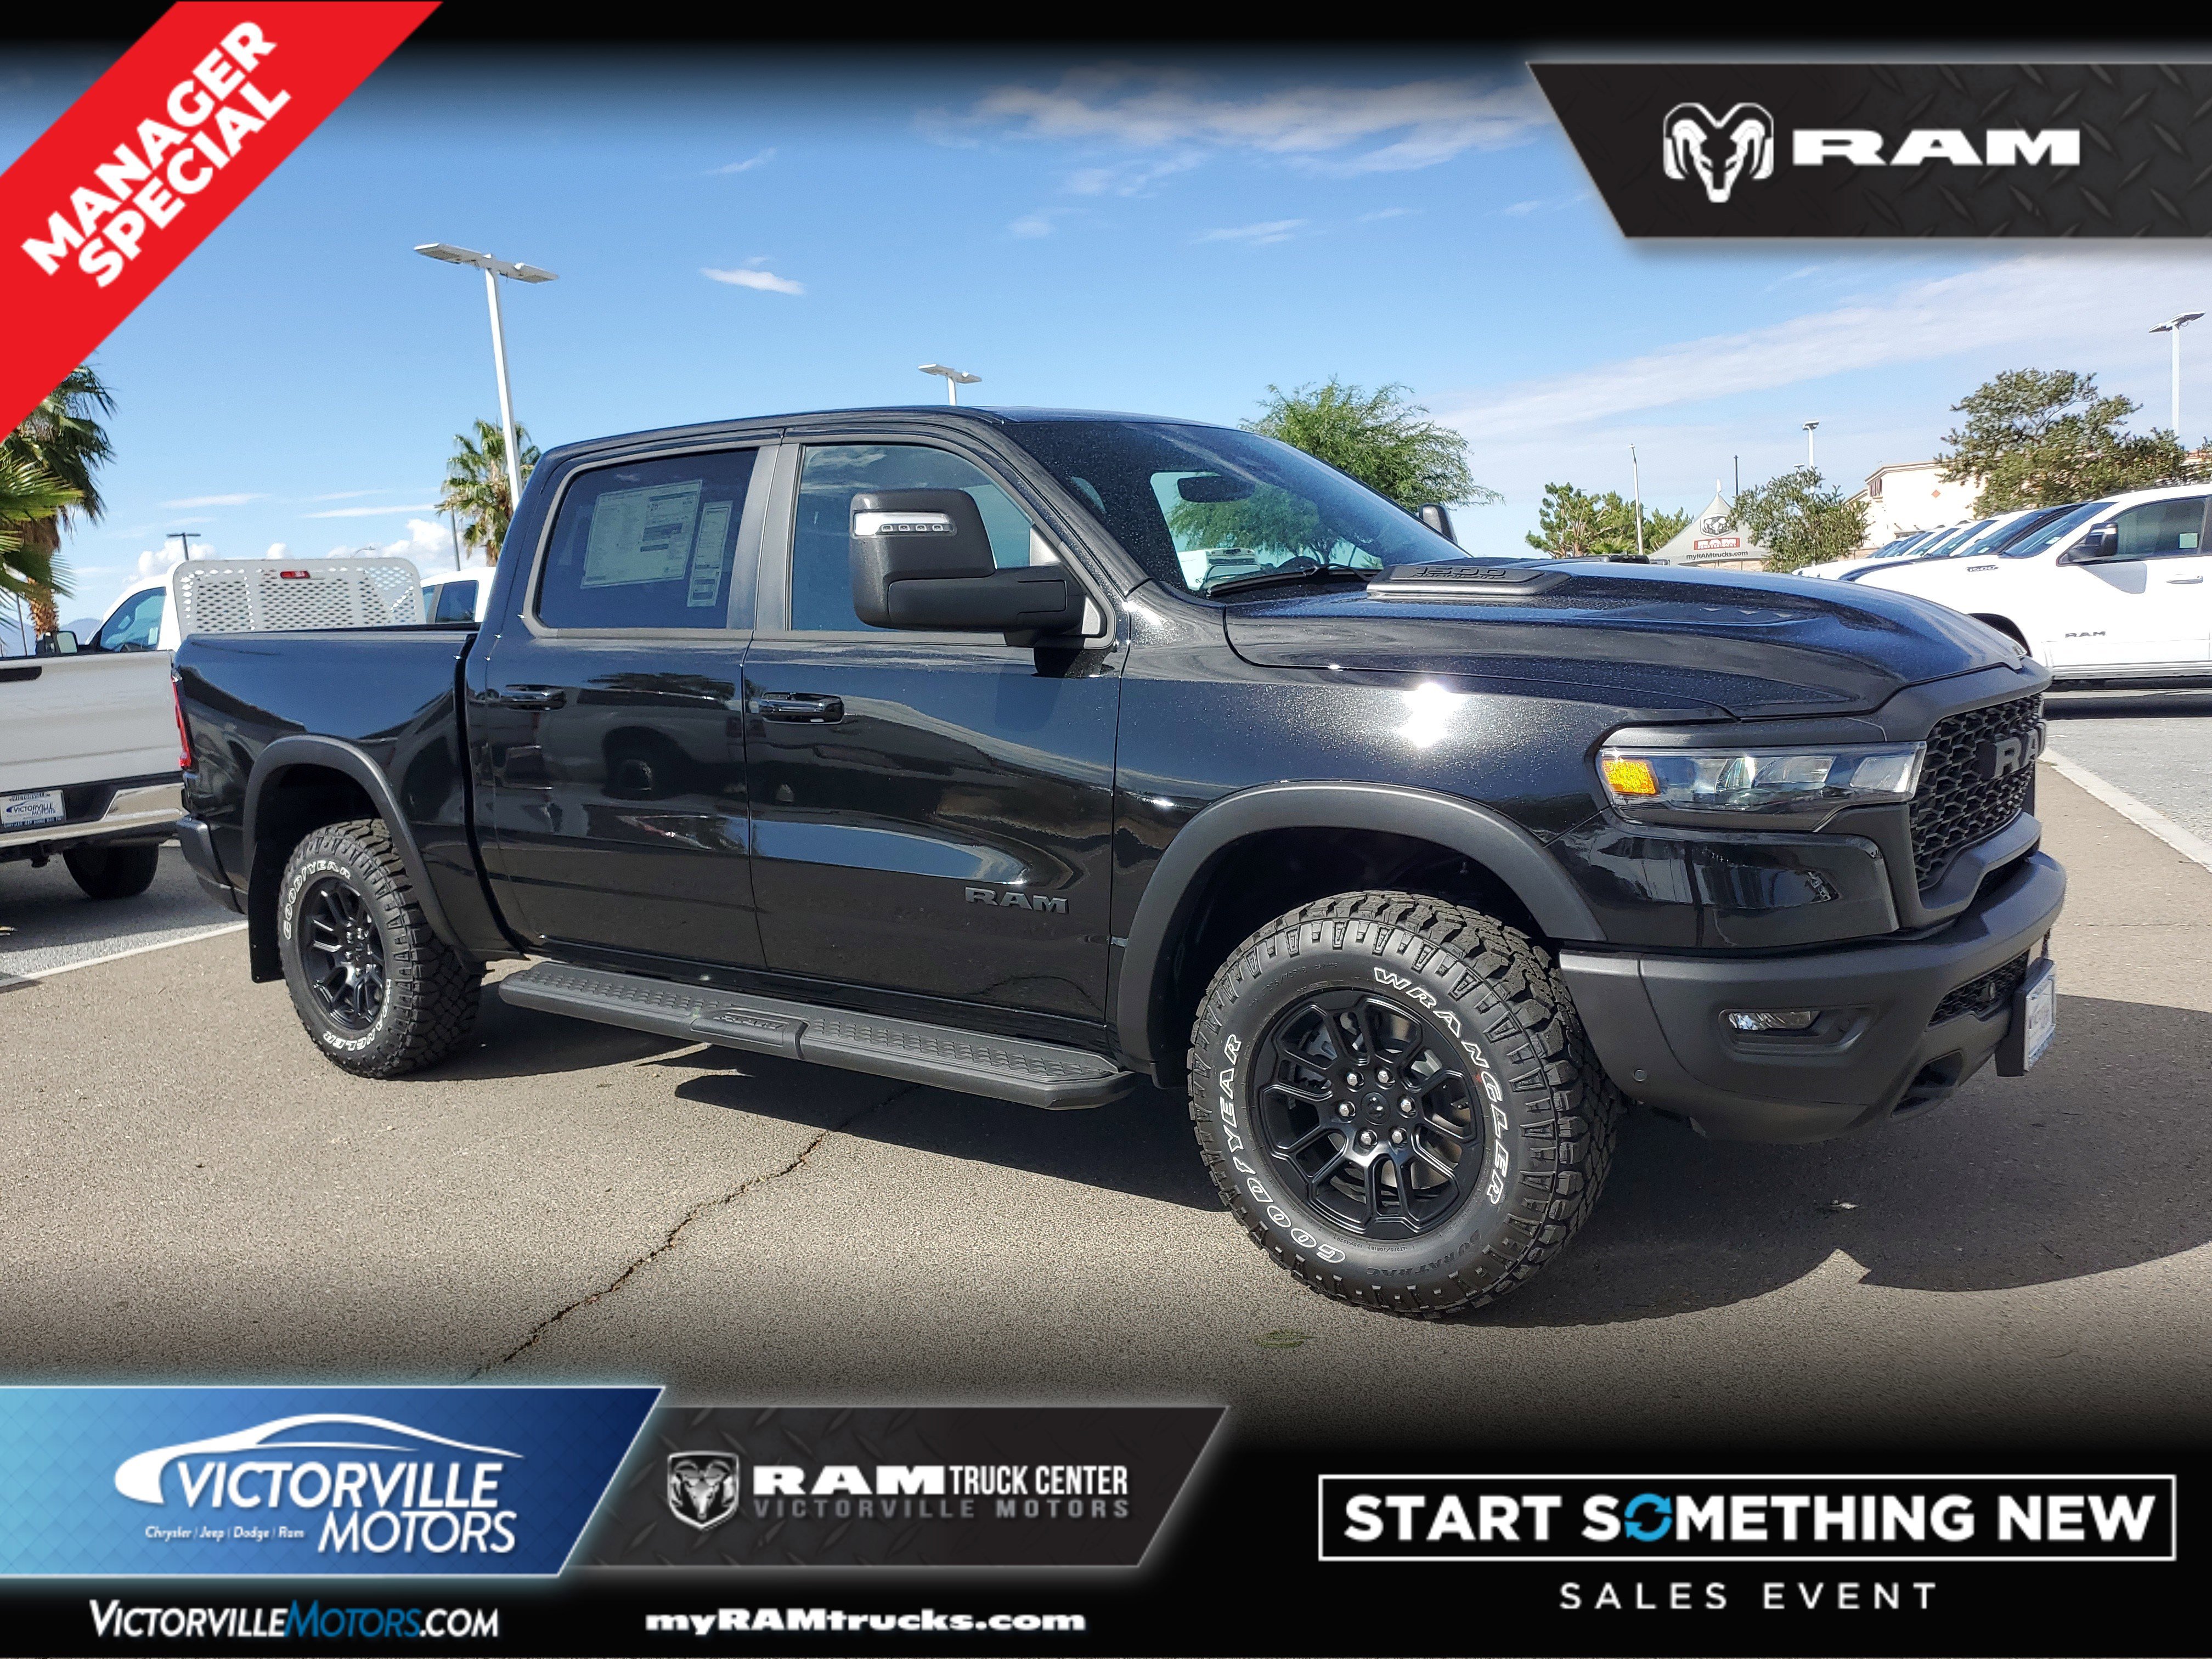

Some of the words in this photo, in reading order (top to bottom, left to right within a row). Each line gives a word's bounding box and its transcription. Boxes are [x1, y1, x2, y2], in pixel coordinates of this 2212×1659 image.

[1686, 551, 1748, 560] myRAMtrucks.com
[965, 887, 1069, 914] RAM
[1219, 1034, 1346, 1263] GOODYEAR
[1374, 967, 1509, 1205] WRANGLER
